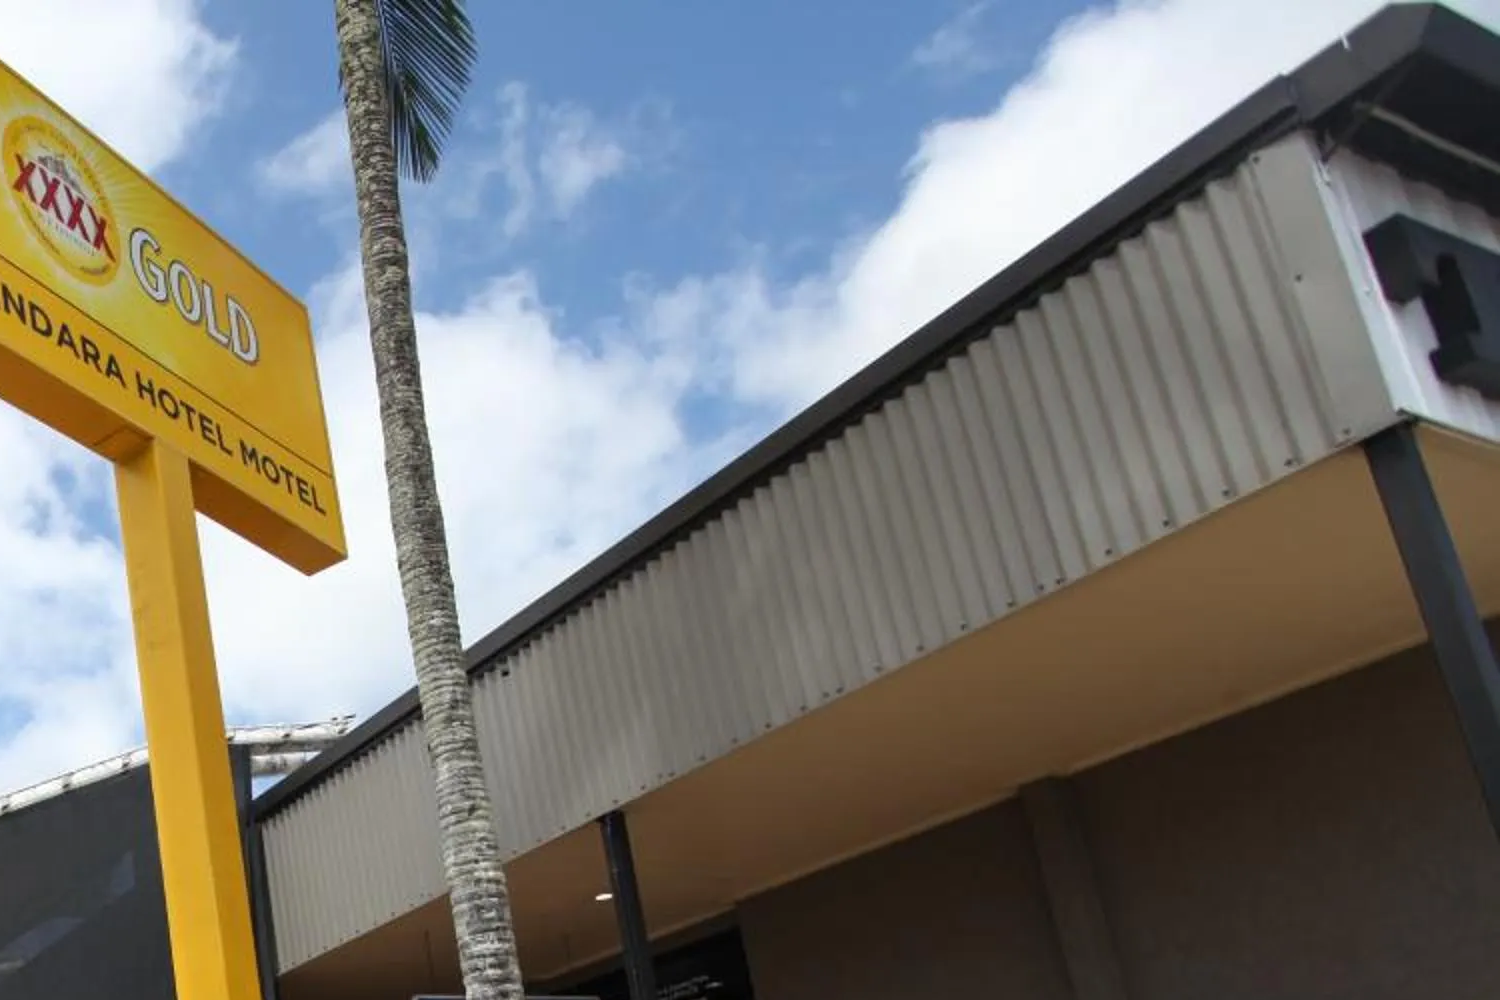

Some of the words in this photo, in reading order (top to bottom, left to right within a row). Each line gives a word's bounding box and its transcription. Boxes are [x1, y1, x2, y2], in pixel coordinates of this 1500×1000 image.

[12, 153, 116, 263] XXXX
[128, 226, 260, 366] GOLD
[136, 370, 233, 457] HOTEL
[240, 439, 328, 517] MOTEL
